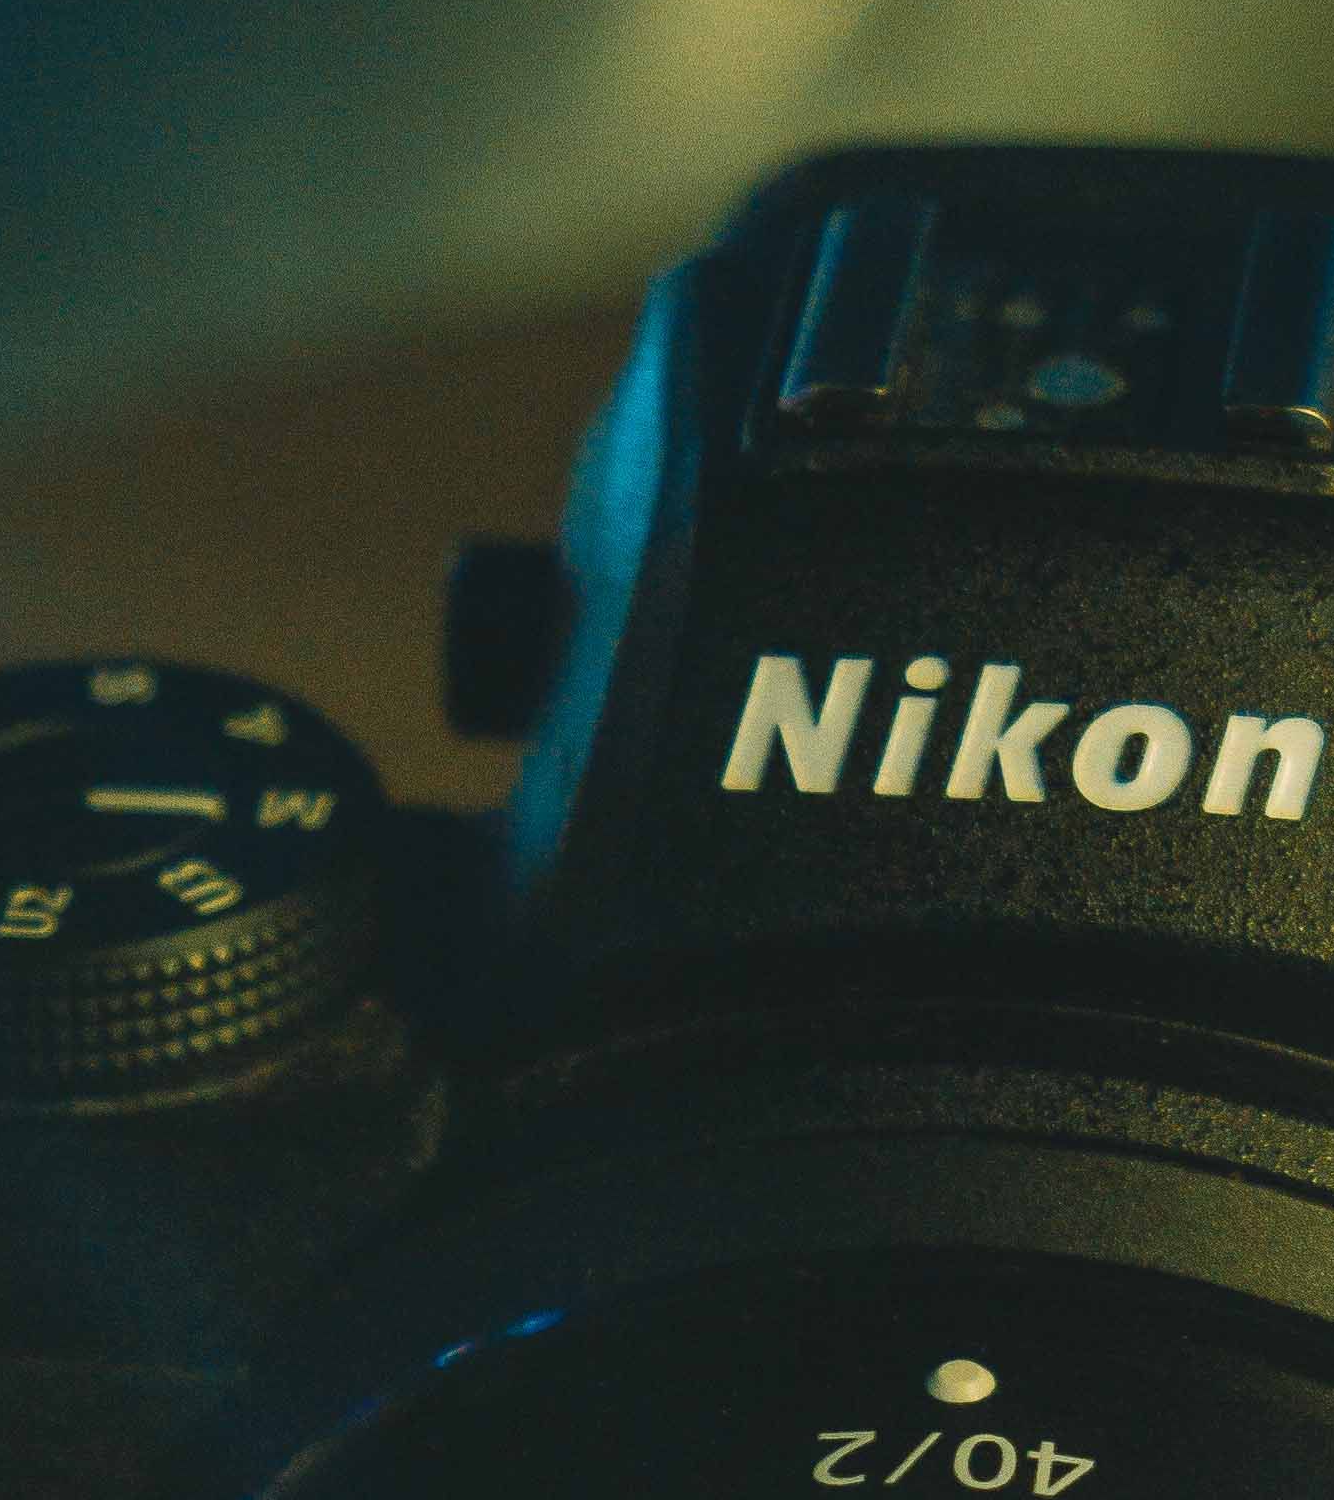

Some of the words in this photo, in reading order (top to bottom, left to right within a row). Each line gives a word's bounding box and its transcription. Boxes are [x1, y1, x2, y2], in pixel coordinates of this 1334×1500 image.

[720, 654, 1327, 822] Nikon
[256, 789, 336, 831] M
[812, 1431, 1097, 1497] 40/2
